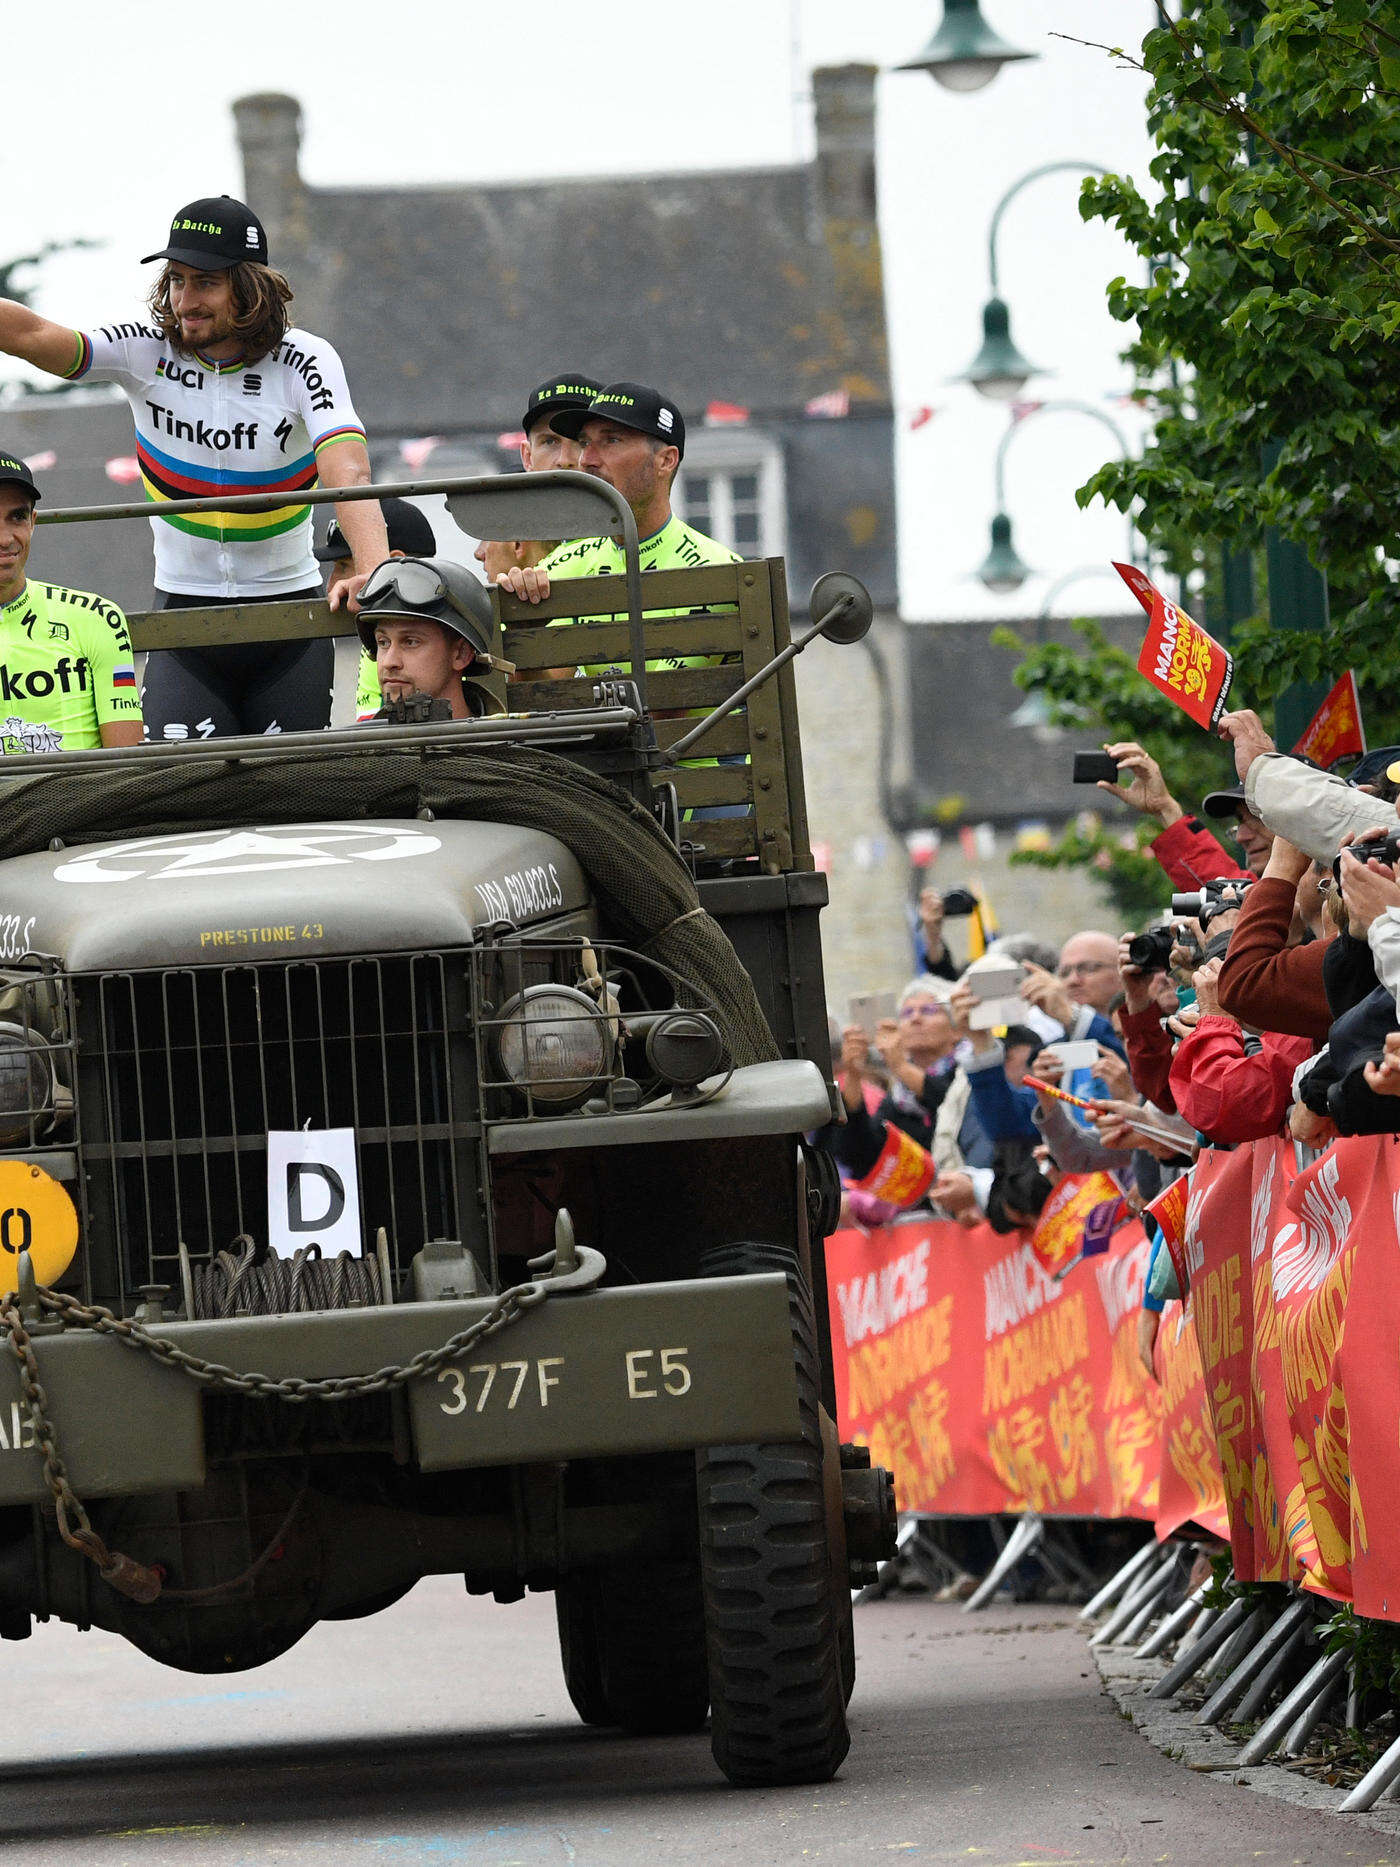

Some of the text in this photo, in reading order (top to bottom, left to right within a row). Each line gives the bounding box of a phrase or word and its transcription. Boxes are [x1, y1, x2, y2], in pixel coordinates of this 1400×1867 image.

[182, 219, 222, 234] Datcha
[93, 322, 166, 343] Tinko
[164, 361, 204, 390] UCI
[272, 341, 334, 412] Tinkoff
[555, 384, 597, 398] Datcha
[145, 399, 259, 451] Tinkoff
[6, 593, 31, 614] Tinkoff
[40, 585, 131, 653] Tinkoff
[110, 698, 142, 711] Tinko
[1212, 696, 1224, 722] GRAND
[474, 880, 511, 922] USA
[200, 923, 324, 947] PRESTONE 43
[286, 1162, 345, 1233] D
[437, 1347, 692, 1416] 377F E5
